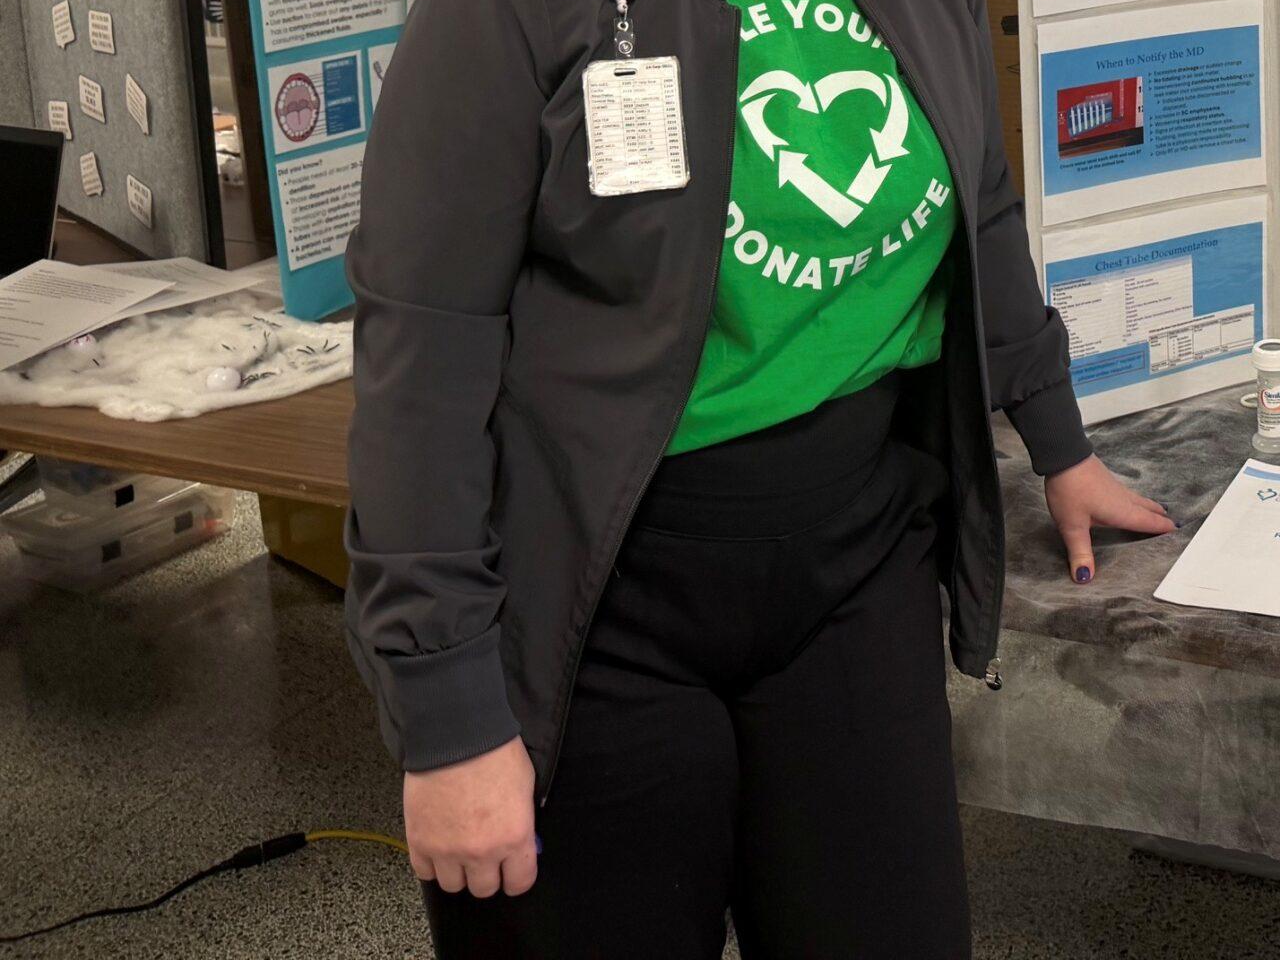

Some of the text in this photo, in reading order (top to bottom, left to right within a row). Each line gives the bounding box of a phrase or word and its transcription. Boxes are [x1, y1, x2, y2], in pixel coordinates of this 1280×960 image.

[1096, 47, 1205, 70] When to Notify the MD
[278, 159, 322, 177] Did you know?
[725, 177, 950, 290] DONATE LIFE
[1094, 239, 1219, 272] Chest Tube Documentation
